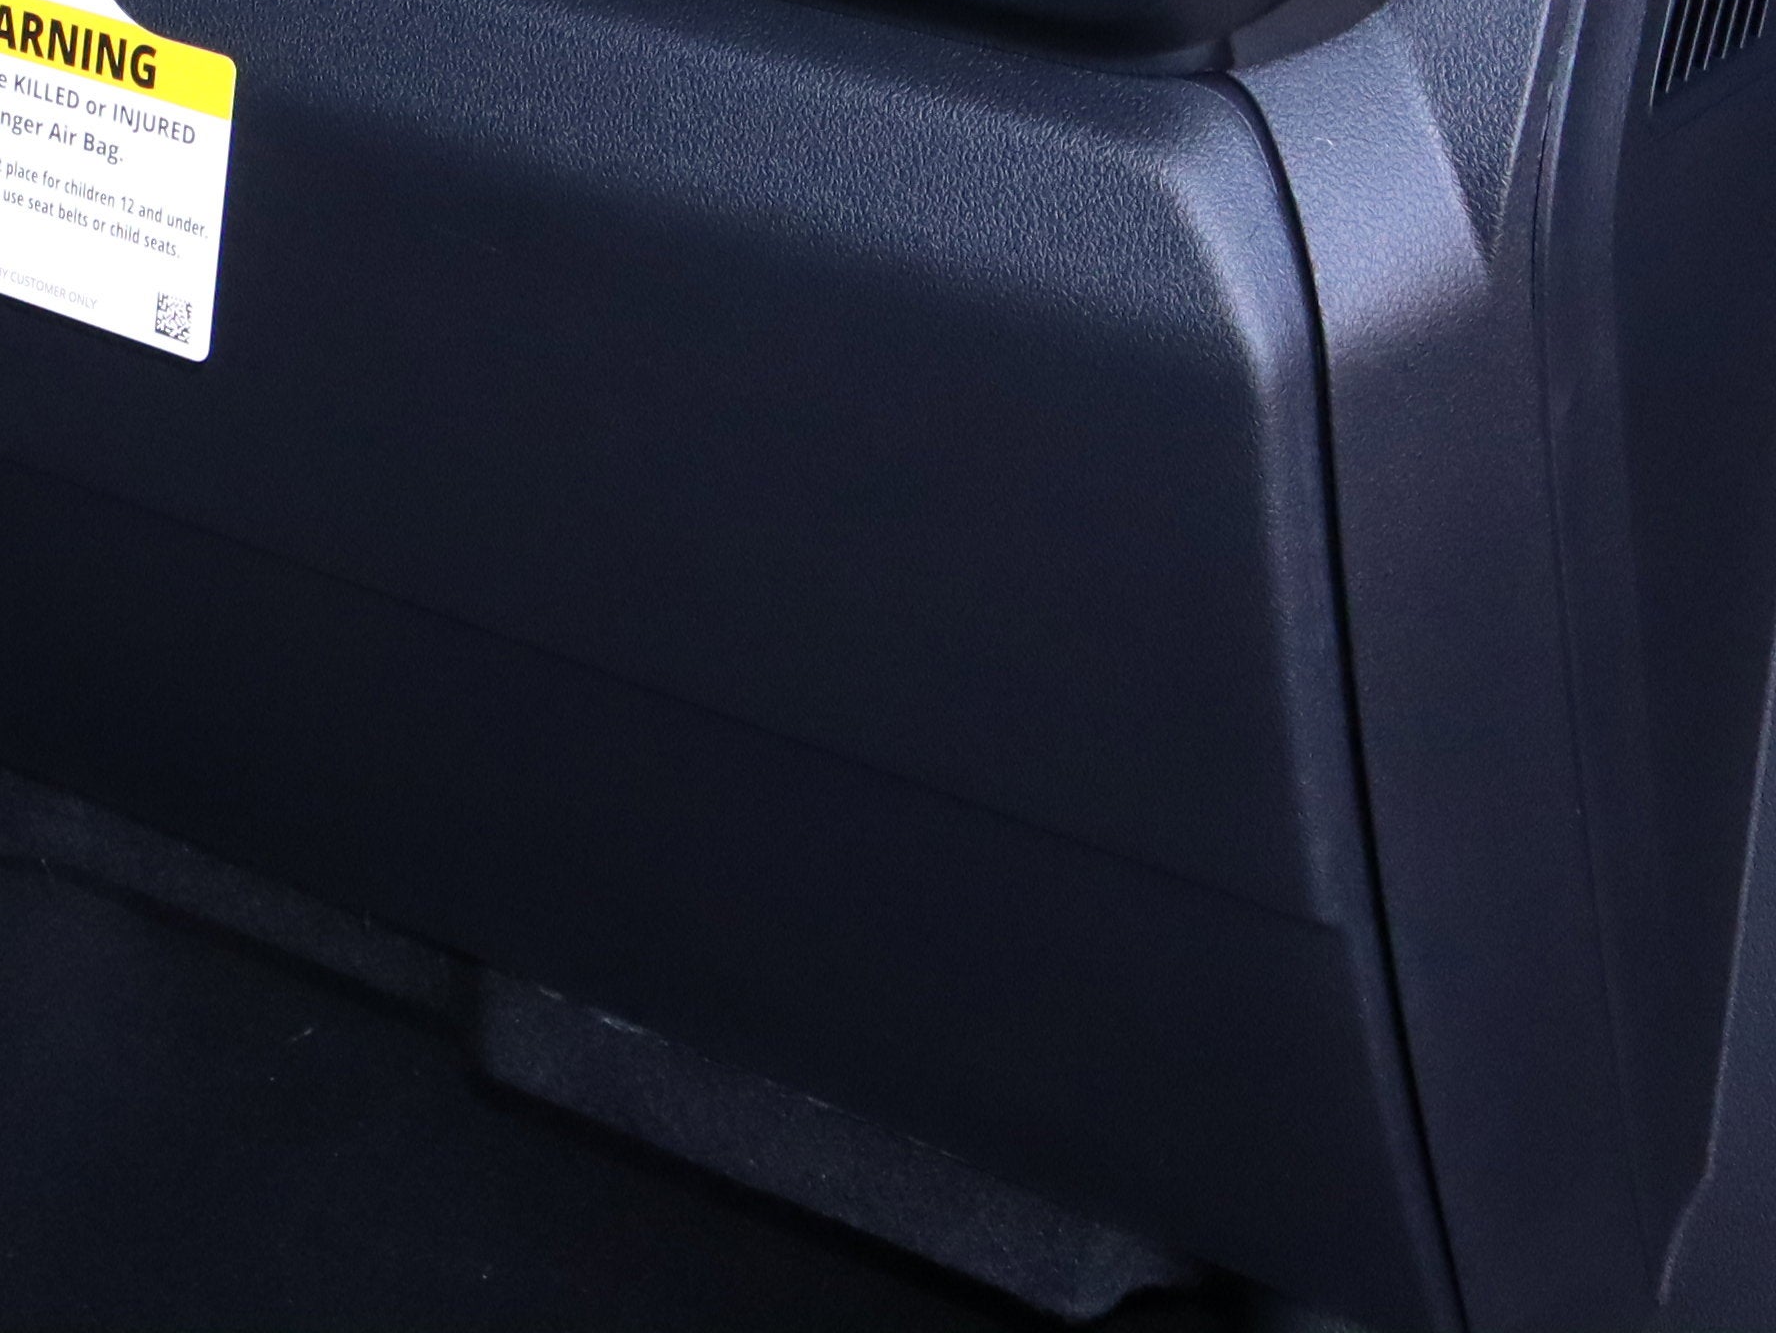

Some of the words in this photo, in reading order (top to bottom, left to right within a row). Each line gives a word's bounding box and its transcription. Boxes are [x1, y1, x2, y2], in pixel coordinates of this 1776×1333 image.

[13, 73, 80, 110] KILLED
[84, 99, 107, 118] or
[112, 102, 196, 145] INJURED
[47, 121, 78, 146] Air
[82, 131, 123, 166] Bag.
[2, 189, 25, 207] use
[27, 196, 54, 217] seat
[57, 202, 89, 228] belts
[91, 217, 107, 233] or
[109, 221, 141, 245] child
[143, 234, 180, 258] seats.
[4, 160, 39, 184] place
[41, 169, 61, 190] for
[63, 178, 116, 208] children
[120, 195, 135, 215] 12
[137, 204, 163, 224] and
[166, 213, 208, 239] under.
[10, 269, 66, 300] CUSTOMER
[66, 289, 99, 311] ONLY
